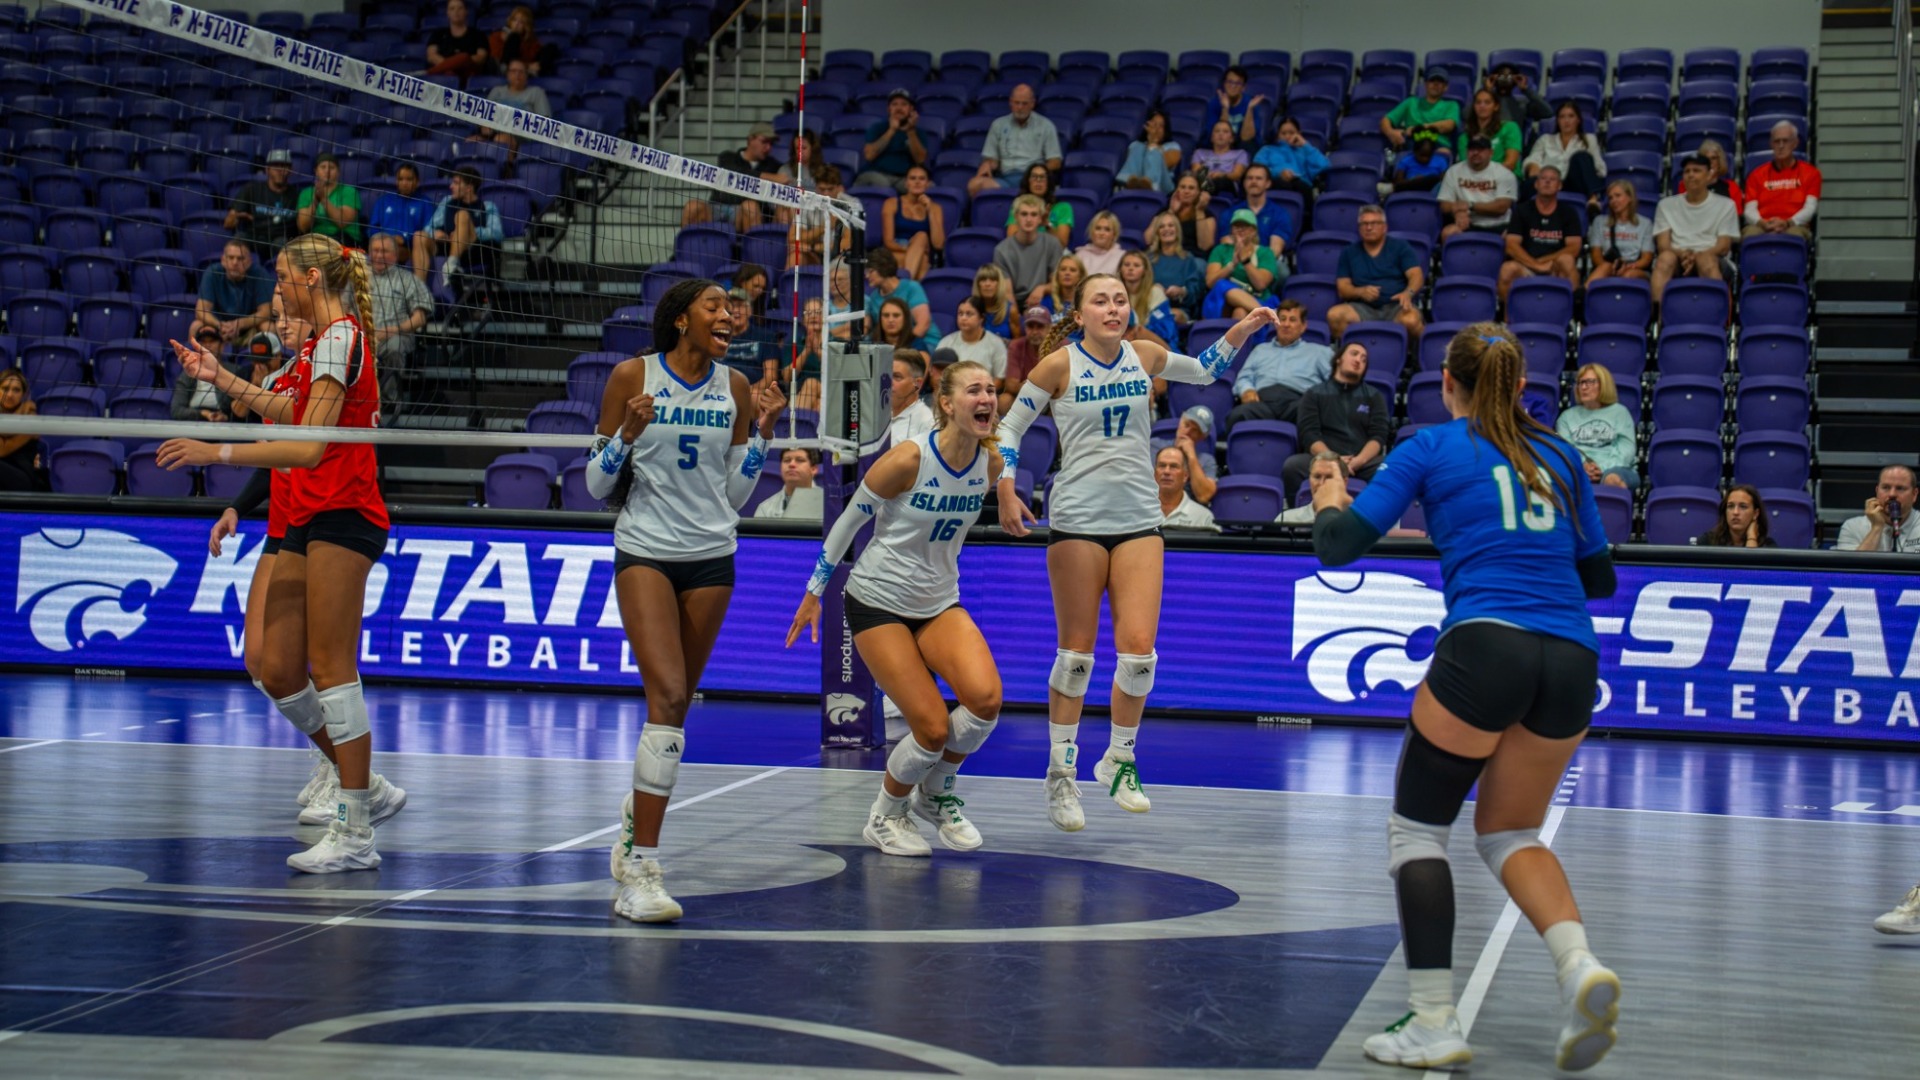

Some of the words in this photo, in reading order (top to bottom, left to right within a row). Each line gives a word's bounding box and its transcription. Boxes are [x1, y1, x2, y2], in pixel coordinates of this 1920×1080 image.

[186, 10, 252, 48] K-STATE
[289, 41, 344, 77] K-STATE
[377, 69, 425, 101] K-STATE
[454, 92, 497, 122] K-STATE
[522, 112, 562, 140] K-STATE
[583, 132, 619, 155] K-STATE
[1075, 379, 1148, 402] ISLANDERS
[647, 405, 732, 428] SLANDERS
[1102, 404, 1131, 437] 17
[677, 434, 700, 470] 5
[909, 491, 985, 513] ISLANDERS
[928, 518, 964, 542] 16
[225, 625, 639, 672] VLEYBALL
[840, 629, 853, 682] imports
[1256, 715, 1313, 725] DAKTRONICS
